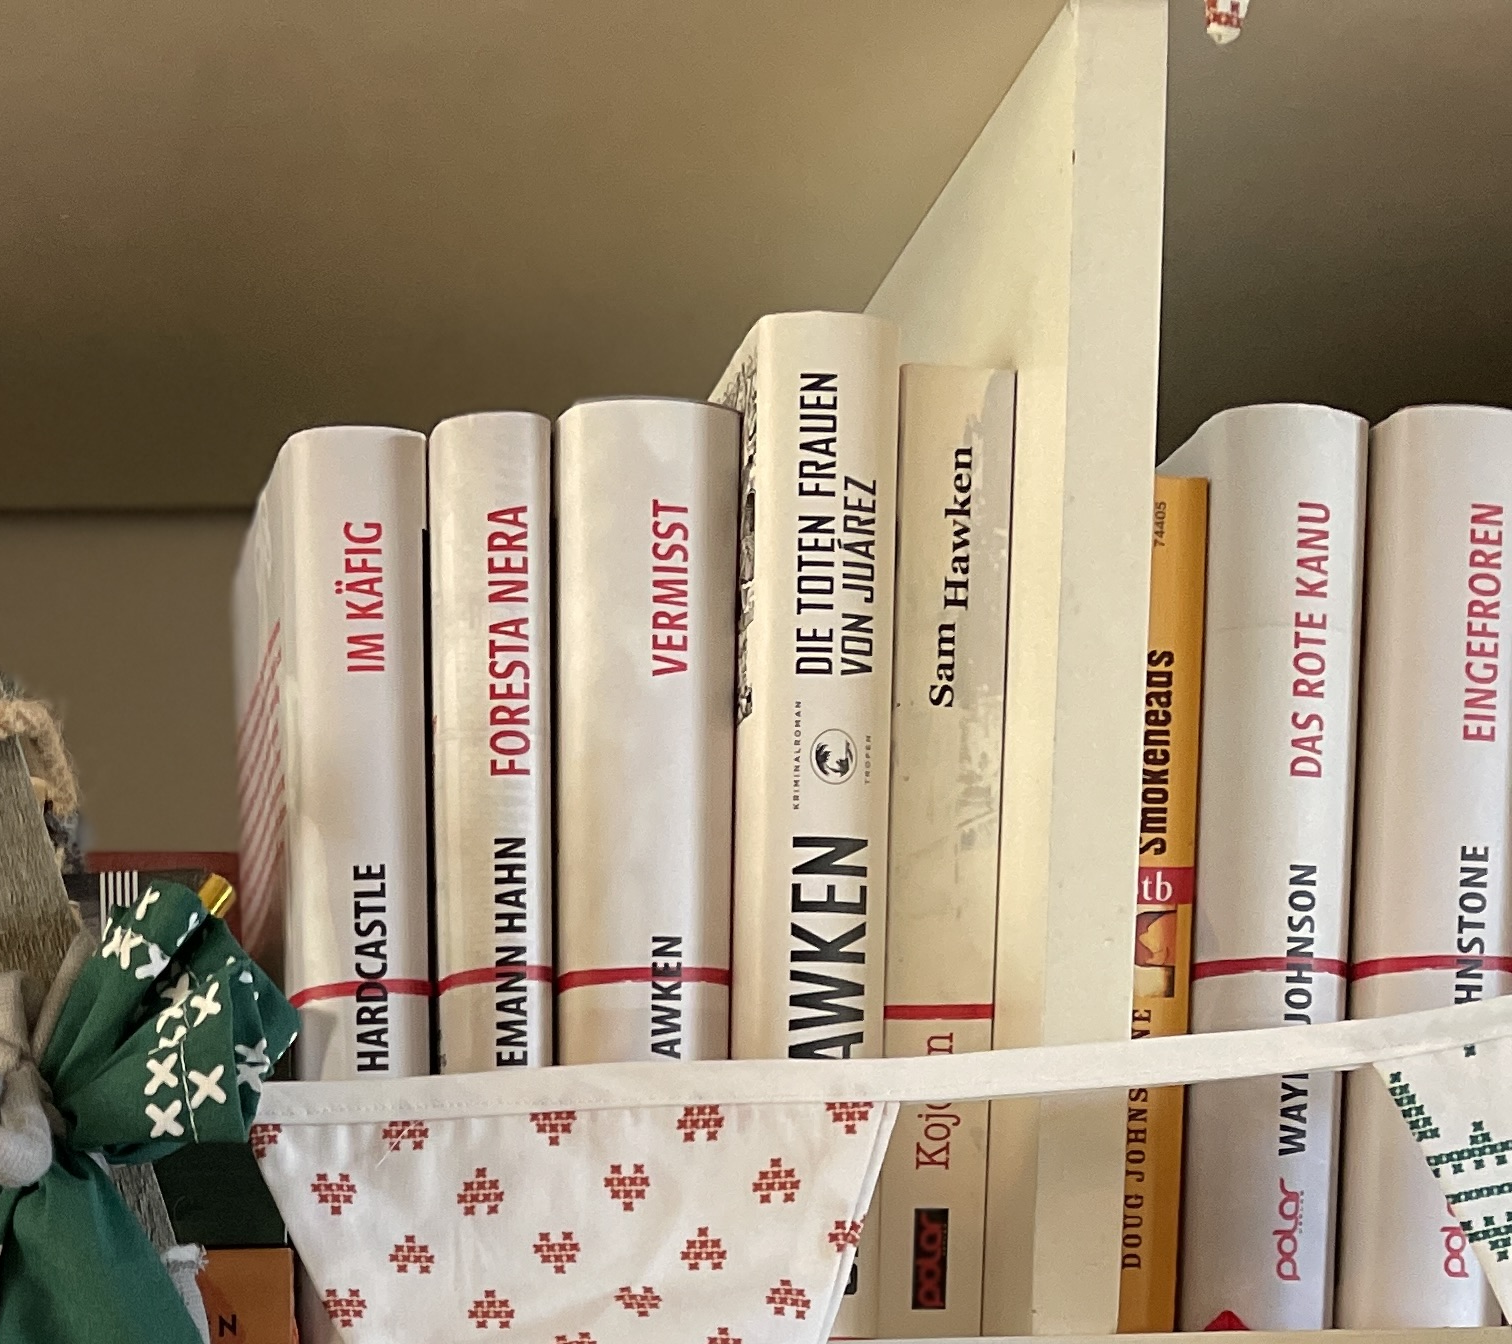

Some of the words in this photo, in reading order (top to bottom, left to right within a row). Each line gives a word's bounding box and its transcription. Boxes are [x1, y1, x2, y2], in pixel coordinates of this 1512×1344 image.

[798, 373, 838, 497] FRAUEN
[335, 520, 383, 626] KÄFIG
[487, 505, 529, 604] NERA
[796, 515, 835, 615] TOTEN
[838, 476, 877, 603] JUÁREZ
[1153, 501, 1167, 547] 74405
[1295, 501, 1331, 599] KANU
[651, 499, 689, 677] VERMISST
[929, 623, 955, 708] Sam
[943, 446, 972, 611] Hawken
[1462, 503, 1504, 742] EINGEFROREN
[347, 635, 385, 672] IM
[488, 616, 531, 777] FORESTA
[795, 628, 833, 676] DIE
[841, 613, 874, 676] VON
[1293, 612, 1328, 699] ROTE
[793, 701, 802, 810] KRIMINALROMAN
[1290, 711, 1324, 778] DAS
[494, 837, 527, 935] HAHN
[353, 863, 388, 1073] HARDCASTLE
[651, 935, 683, 1060] AWKEN
[788, 836, 869, 1060] AWKEN
[495, 944, 528, 1067] EMANN
[1122, 1194, 1144, 1270] DOUG
[1273, 1177, 1300, 1281] polar
